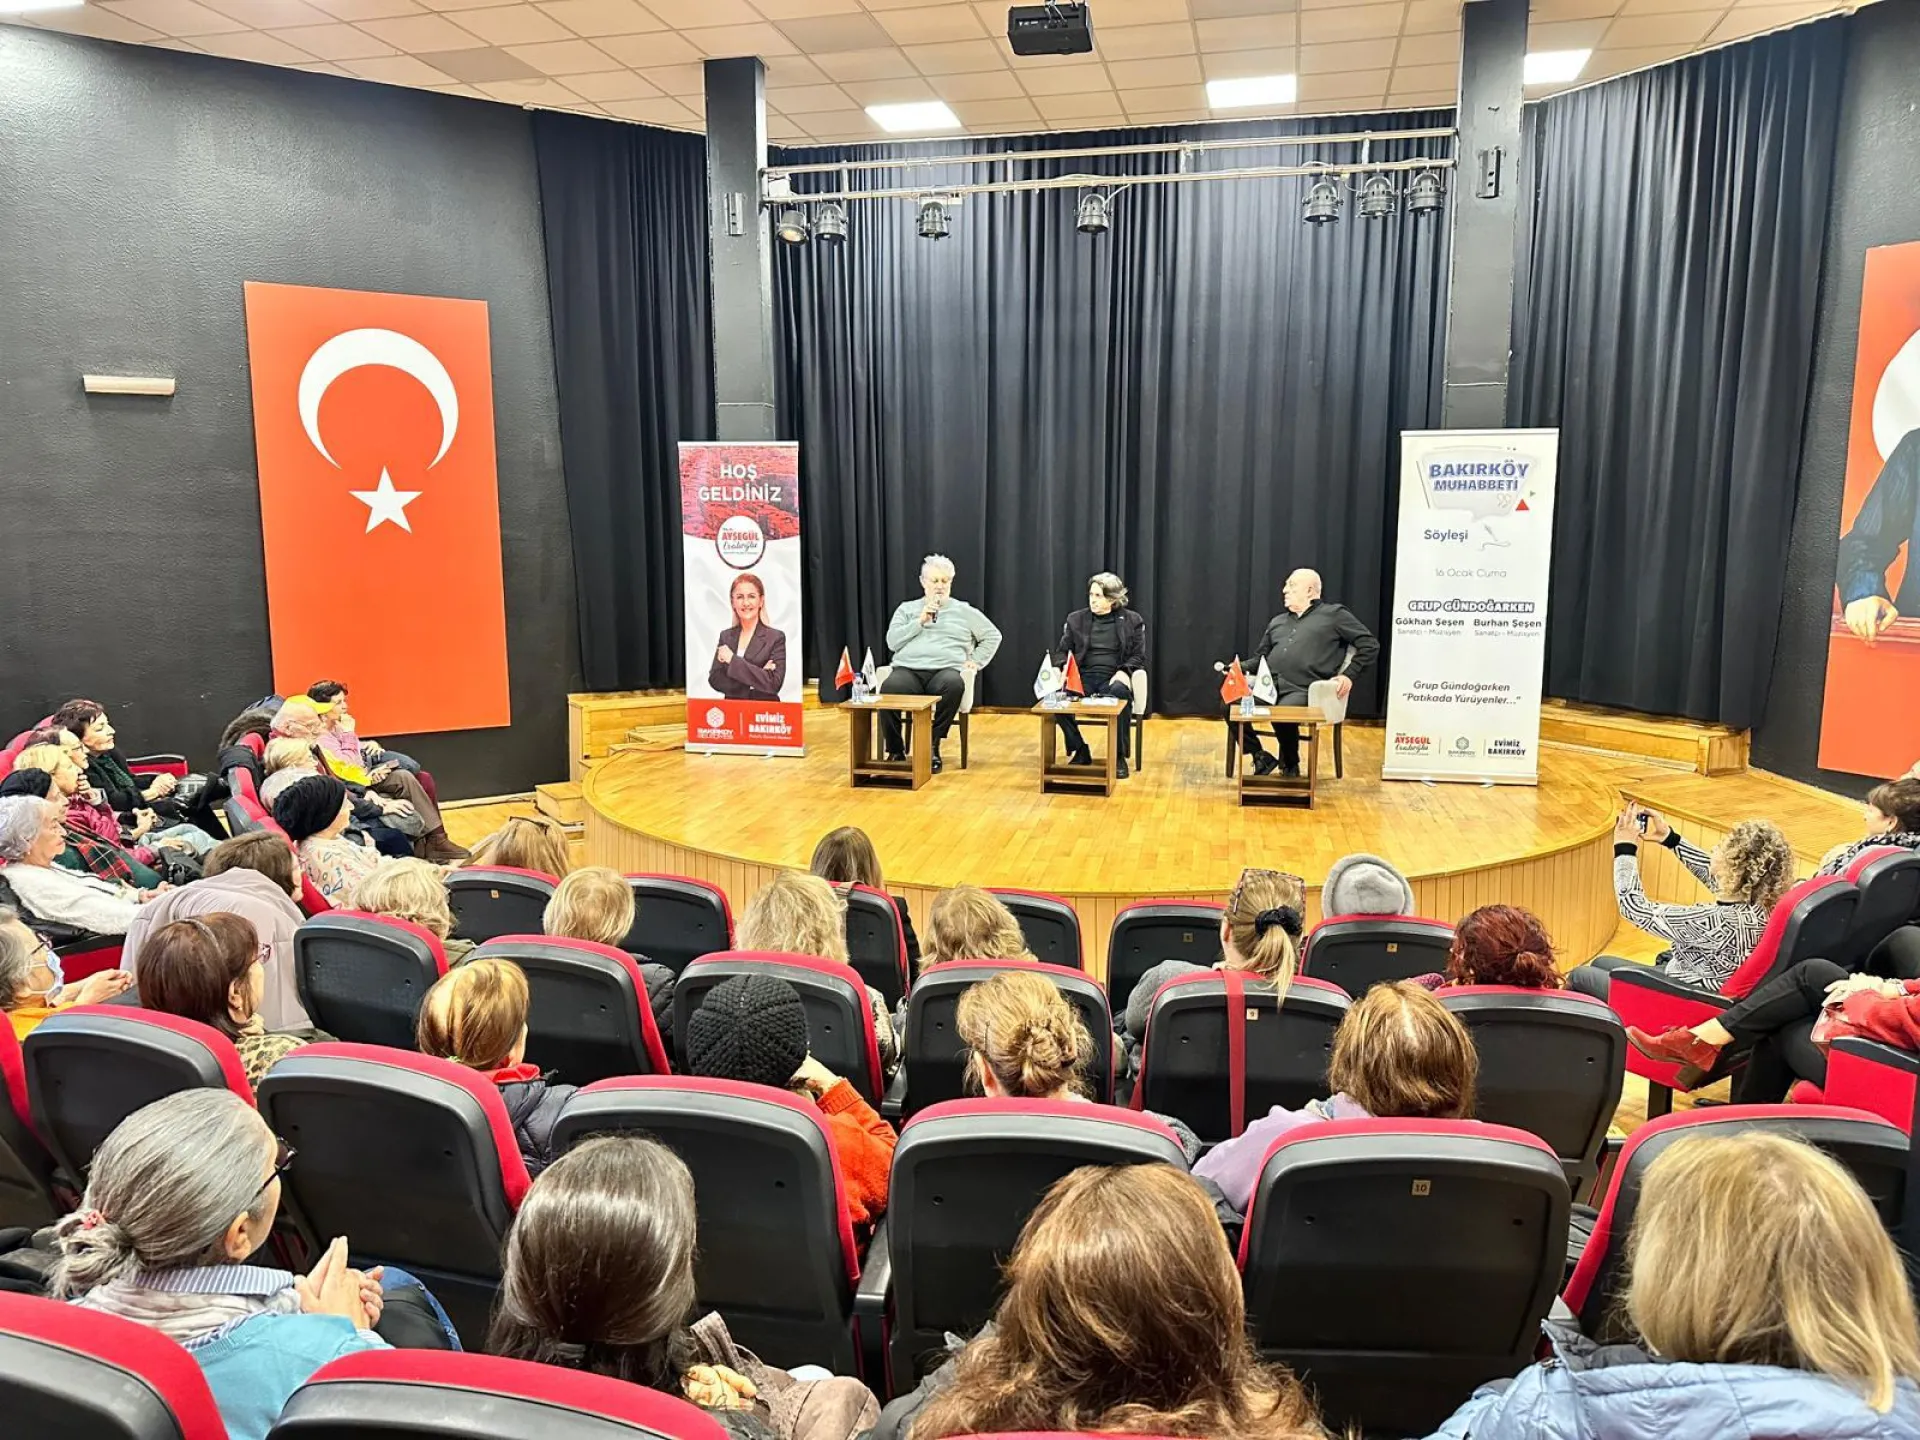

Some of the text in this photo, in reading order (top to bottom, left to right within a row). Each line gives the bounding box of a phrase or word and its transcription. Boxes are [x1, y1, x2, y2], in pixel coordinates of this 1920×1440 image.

[720, 464, 757, 482] HOŞ
[1429, 459, 1529, 478] BAKIRKÖY
[1434, 477, 1519, 491] MUHABBETİ
[699, 483, 782, 502] GELDİNİZ
[1424, 529, 1469, 543] Söyleşi
[1435, 568, 1507, 578] 16 Ocak Cuma
[1408, 599, 1535, 613] GRUP GÜNDOĞARKEN
[1395, 617, 1465, 627] Gökhan Şeşen
[1473, 618, 1542, 628] Burhan Şeşen
[1413, 680, 1510, 692] Grup Gündoğarken
[755, 712, 785, 723] EVİMİZ
[748, 723, 792, 735] BAKIRKÖY
[1494, 738, 1520, 747] EVİMİZ
[1488, 747, 1526, 755] BAKIRKÖY
[1415, 1184, 1427, 1192] 10
